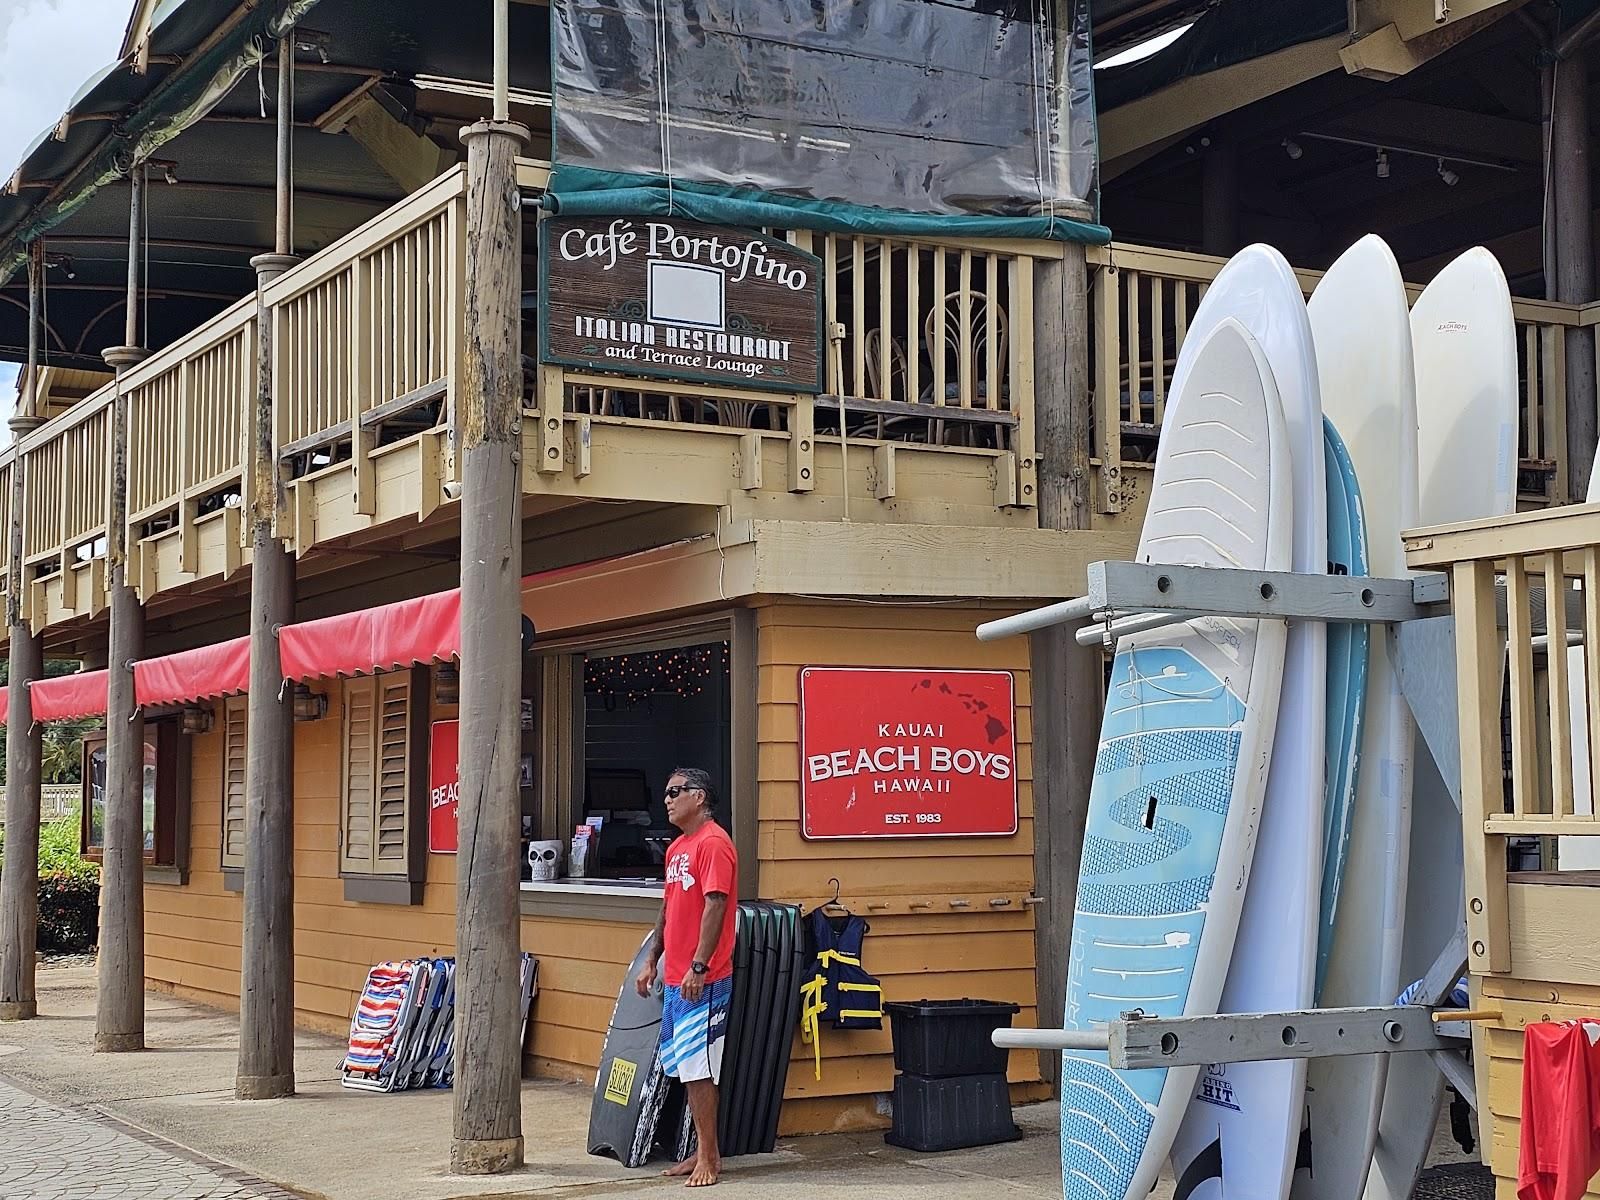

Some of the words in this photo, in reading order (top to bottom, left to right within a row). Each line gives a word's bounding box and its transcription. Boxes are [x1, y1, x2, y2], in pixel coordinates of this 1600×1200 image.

[559, 219, 638, 270] Café
[645, 222, 807, 291] Portofino
[575, 315, 656, 346] ITALIAN
[666, 327, 792, 361] RESTAURANT
[605, 345, 637, 360] and
[641, 347, 701, 367] Terrace
[705, 355, 764, 378] Lounge
[878, 724, 944, 738] KAUAI
[808, 746, 920, 782] BEACH
[930, 746, 1011, 780] BOYS
[874, 778, 950, 794] HAWAII
[885, 814, 910, 824] EST.
[915, 813, 942, 824] 1983
[1203, 1084, 1233, 1103] HIT
